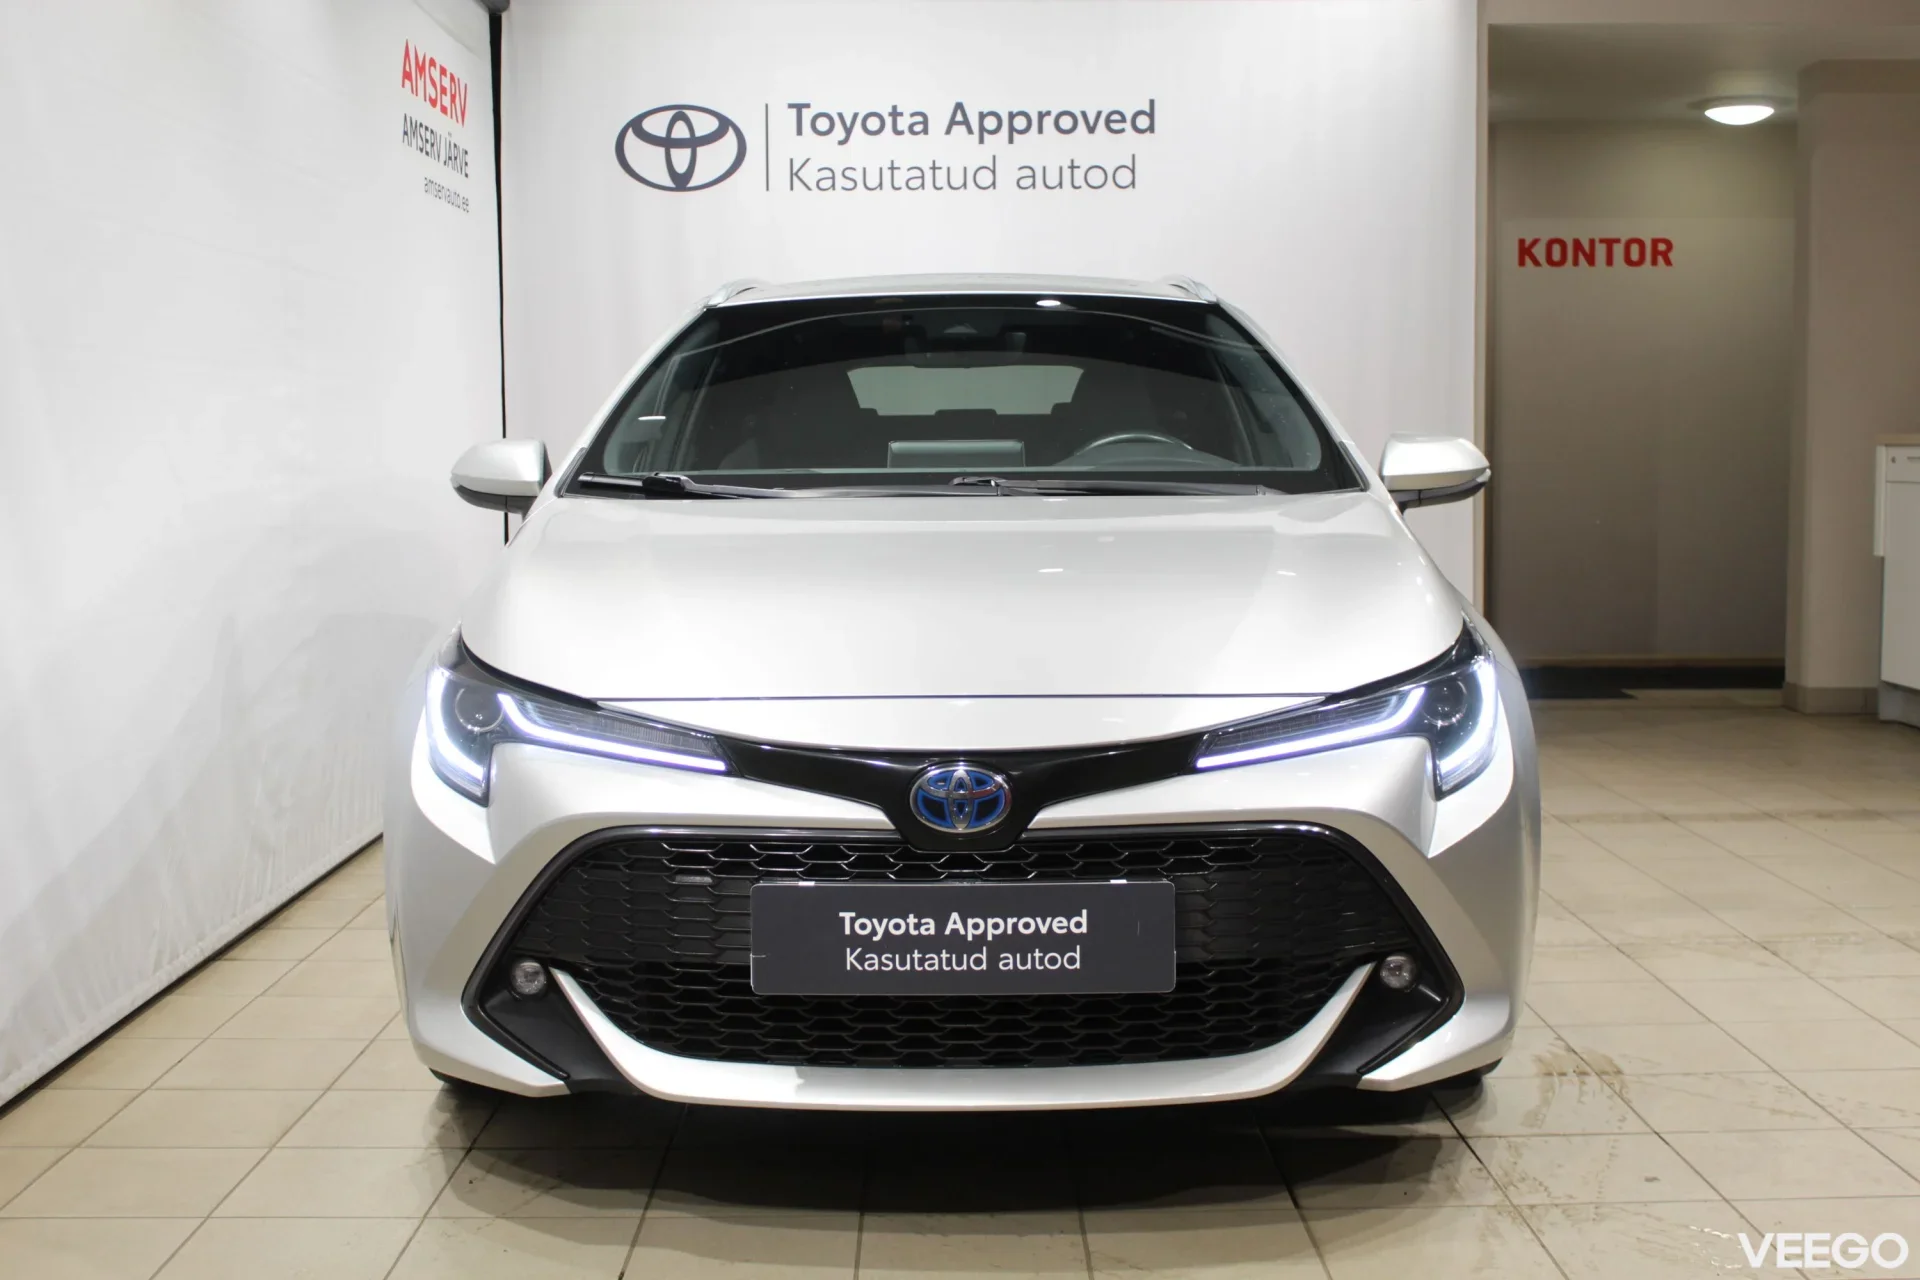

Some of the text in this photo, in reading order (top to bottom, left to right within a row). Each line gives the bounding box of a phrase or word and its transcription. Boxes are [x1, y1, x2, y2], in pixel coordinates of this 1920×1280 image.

[401, 38, 468, 128] AMSERV
[787, 98, 1156, 145] Toyota Approved
[402, 112, 469, 179] AMSERV JÄRVE
[788, 153, 1137, 192] Kasutatud autod
[423, 176, 470, 214] amservauto.ee
[1517, 237, 1674, 268] KONTOR
[838, 909, 1088, 942] Toyota Approved
[845, 945, 1081, 972] Kasutatud autod
